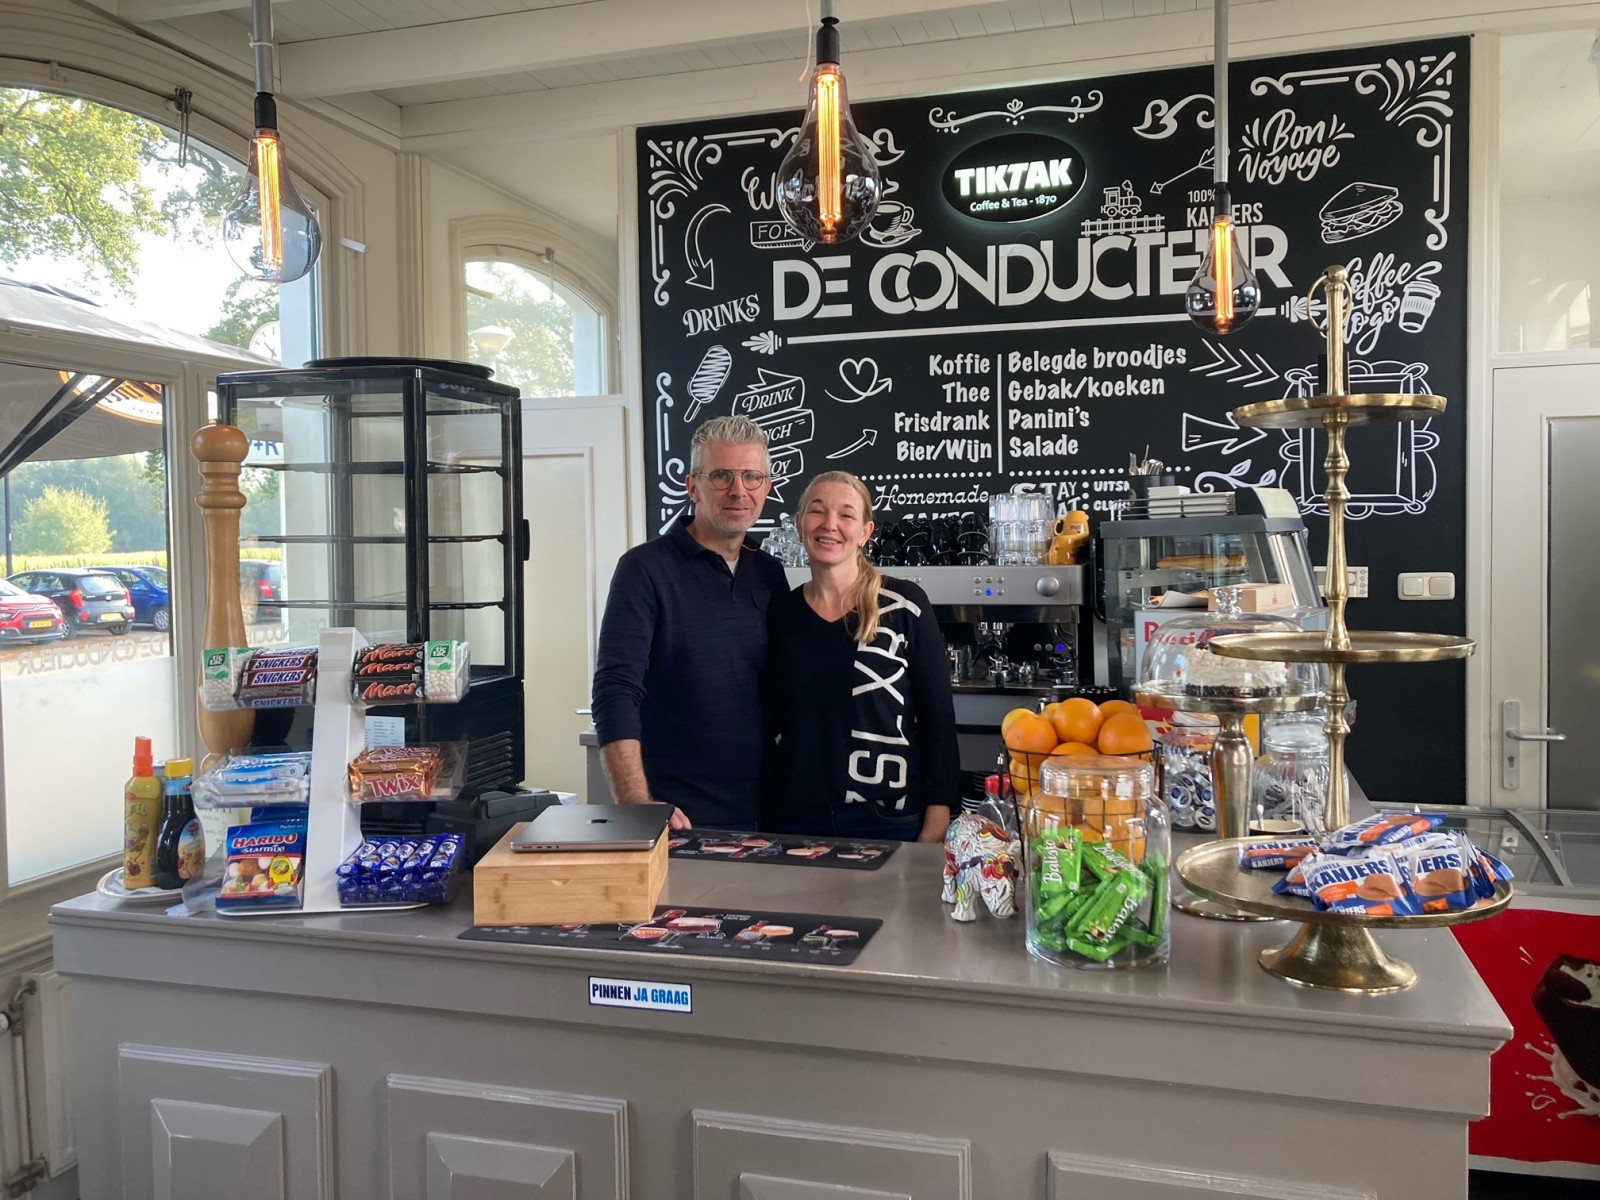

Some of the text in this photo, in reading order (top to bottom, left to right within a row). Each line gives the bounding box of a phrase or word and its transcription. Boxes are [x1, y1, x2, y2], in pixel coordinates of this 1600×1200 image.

[1263, 109, 1326, 156] Bon
[1238, 145, 1341, 185] Voyage
[954, 158, 1073, 196] TIKTAK
[970, 199, 1000, 212] Coffee
[1001, 198, 1010, 208] &
[1011, 197, 1028, 208] Tea
[1035, 194, 1057, 206] 1870
[1187, 189, 1216, 203] 100%
[1186, 202, 1264, 228] KAERS
[773, 255, 852, 321] DE
[683, 293, 760, 337] DRINKS
[929, 353, 991, 376] Koffie
[1008, 344, 1187, 374] Belegde broodjes
[742, 386, 796, 412] DRINK
[942, 382, 991, 403] Thee
[1008, 375, 1165, 402] Gebak/koeken
[894, 410, 991, 433] Frisdrank
[1008, 406, 1090, 430] Panini's
[763, 423, 793, 441] NCH
[896, 439, 992, 463] Bier/Wijn
[1008, 434, 1080, 457] Salade
[872, 484, 989, 512] Homemade
[255, 657, 304, 669] SNICKERS
[362, 648, 417, 662] Mars
[254, 671, 302, 683] SNICKERS
[359, 662, 415, 675] Mars
[361, 682, 417, 699] Mars
[365, 773, 421, 797] Twix
[232, 833, 298, 848] HARIBO
[1044, 839, 1063, 884] Balisto
[1251, 858, 1284, 868] KANJERS
[1310, 860, 1393, 893] KANJERS
[592, 984, 689, 1006] PINNEN JA GRAAG
